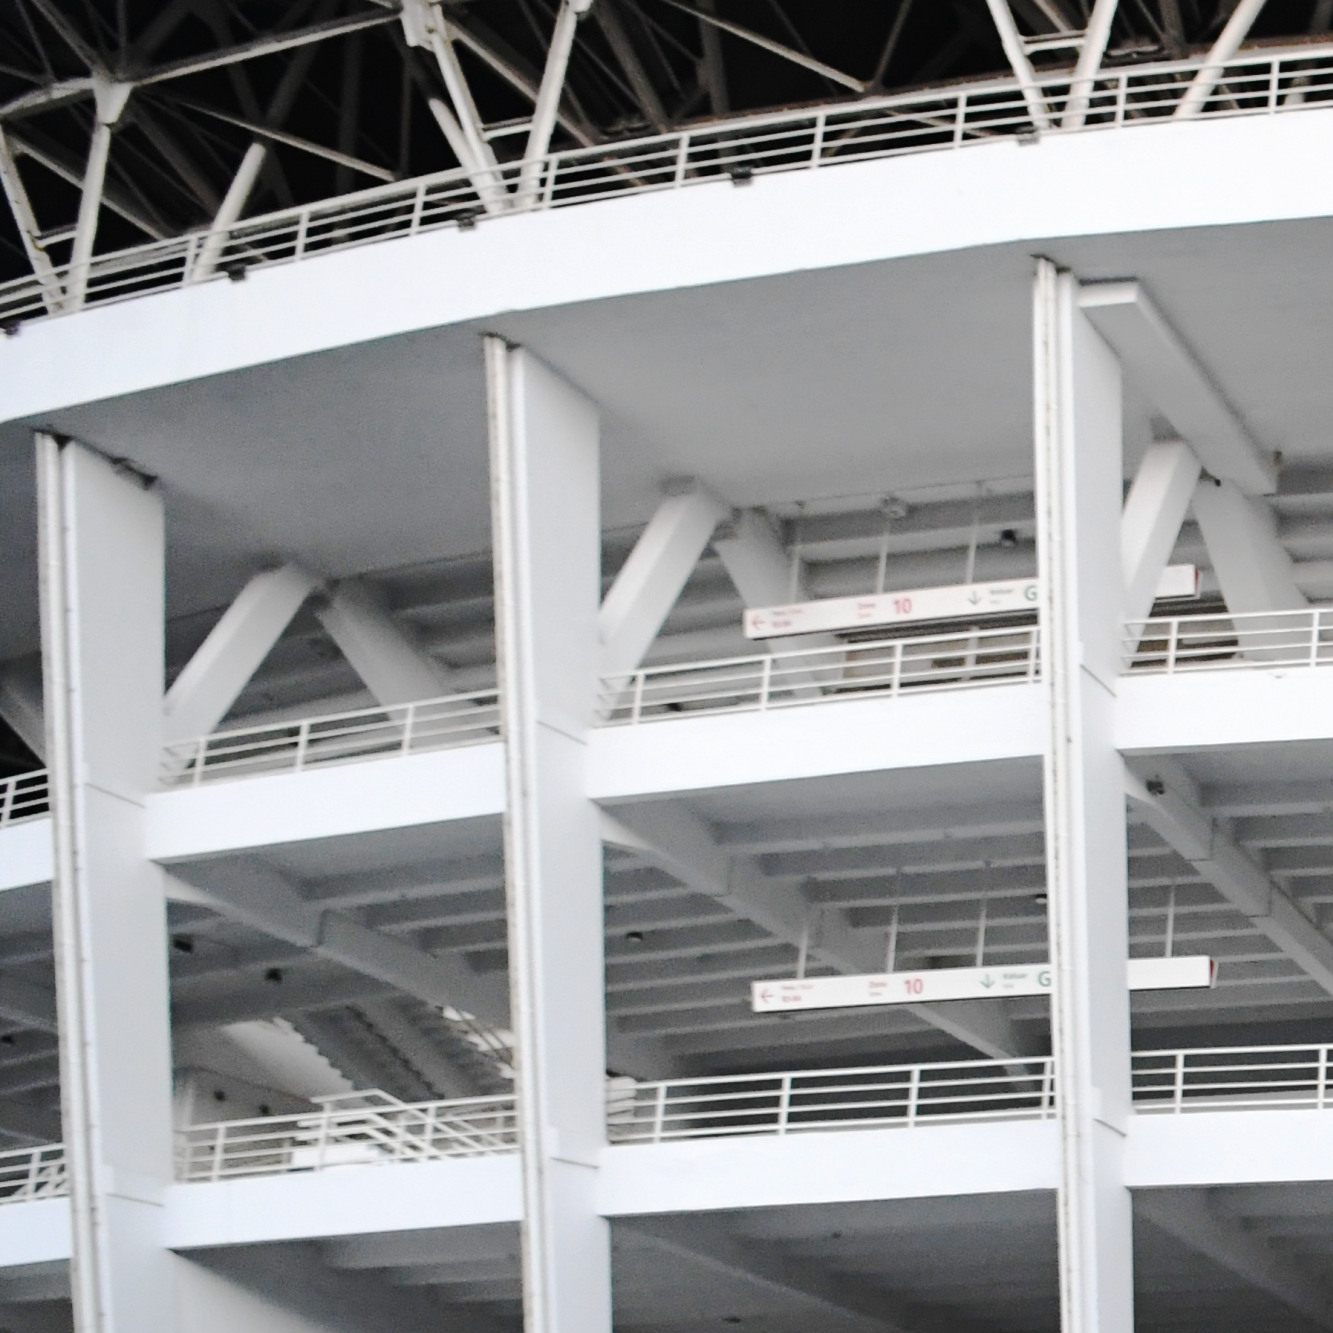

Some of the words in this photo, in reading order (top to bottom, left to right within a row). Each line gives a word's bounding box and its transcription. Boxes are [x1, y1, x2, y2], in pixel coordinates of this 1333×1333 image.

[893, 599, 913, 615] 10
[904, 979, 924, 995] 10
[1038, 971, 1052, 988] G
